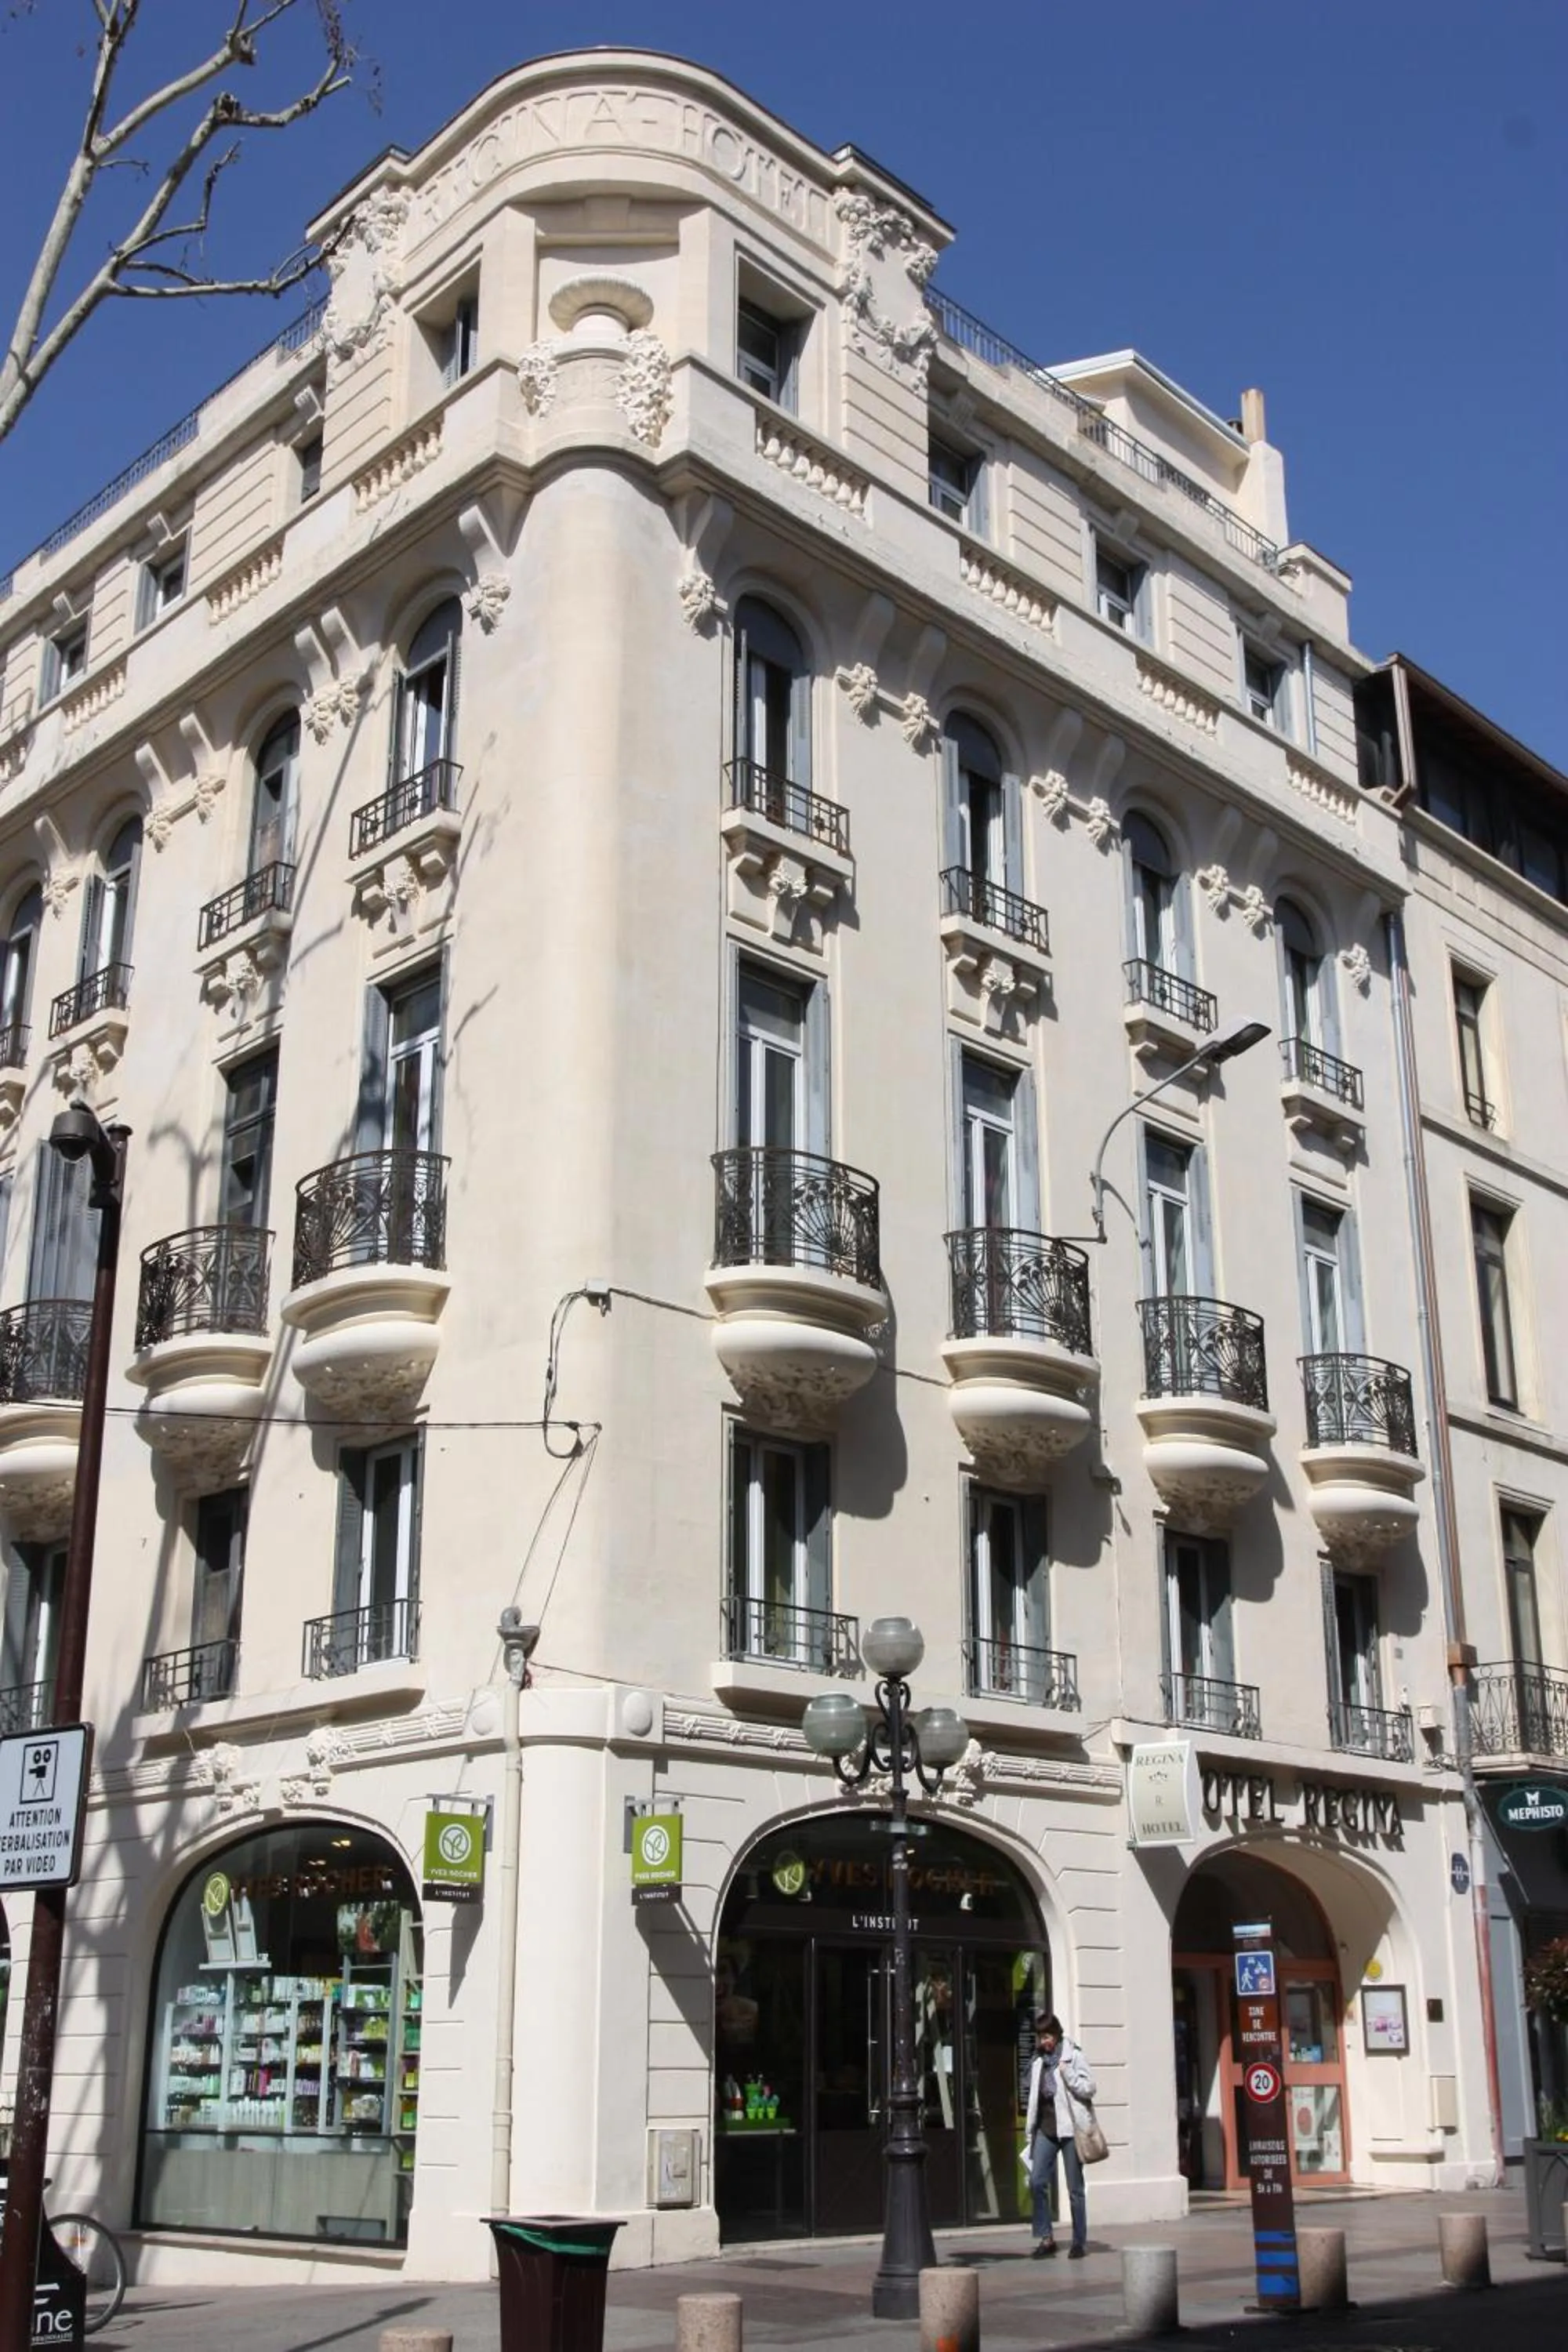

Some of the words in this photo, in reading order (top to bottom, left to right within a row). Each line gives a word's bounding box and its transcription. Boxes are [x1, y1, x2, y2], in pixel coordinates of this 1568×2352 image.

[677, 103, 828, 238] HOTEL
[1136, 1753, 1184, 1767] REGINA
[1202, 1769, 1285, 1822] OTEL
[1302, 1782, 1404, 1835] REGINA
[9, 1808, 61, 1828] ATTENTION
[1508, 1805, 1564, 1821] MEPHISTO
[1142, 1821, 1185, 1835] HOTEL
[4, 1858, 23, 1876] PAR
[27, 1855, 56, 1874] VIDEO
[852, 1915, 919, 1931] L'INSTIT
[1252, 2019, 1262, 2031] DE
[1254, 2074, 1270, 2090] 20
